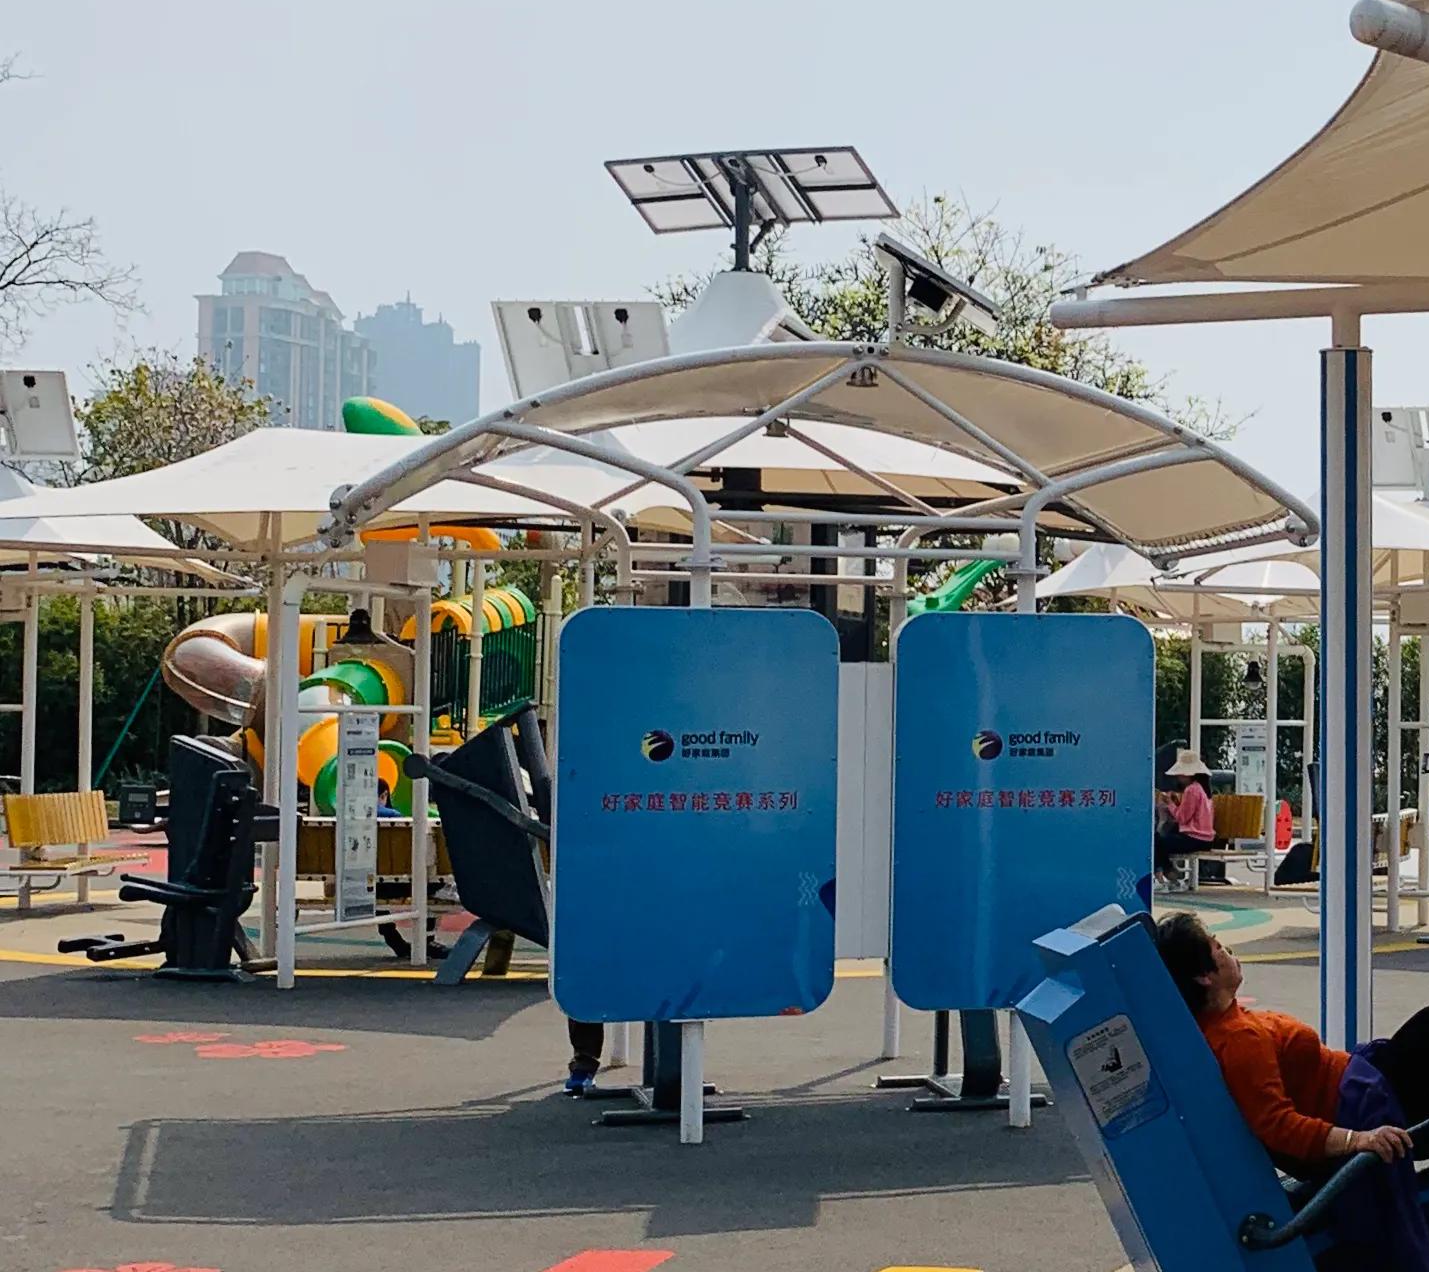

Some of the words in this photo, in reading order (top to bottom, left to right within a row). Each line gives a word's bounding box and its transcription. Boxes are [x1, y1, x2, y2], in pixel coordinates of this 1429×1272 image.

[681, 731, 716, 746] good
[719, 730, 760, 746] family
[1008, 731, 1041, 746] good
[1044, 731, 1081, 746] family
[602, 791, 798, 812] 好家庭智能竞赛系列
[935, 789, 1116, 809] 好家庭智能竞赛系列
